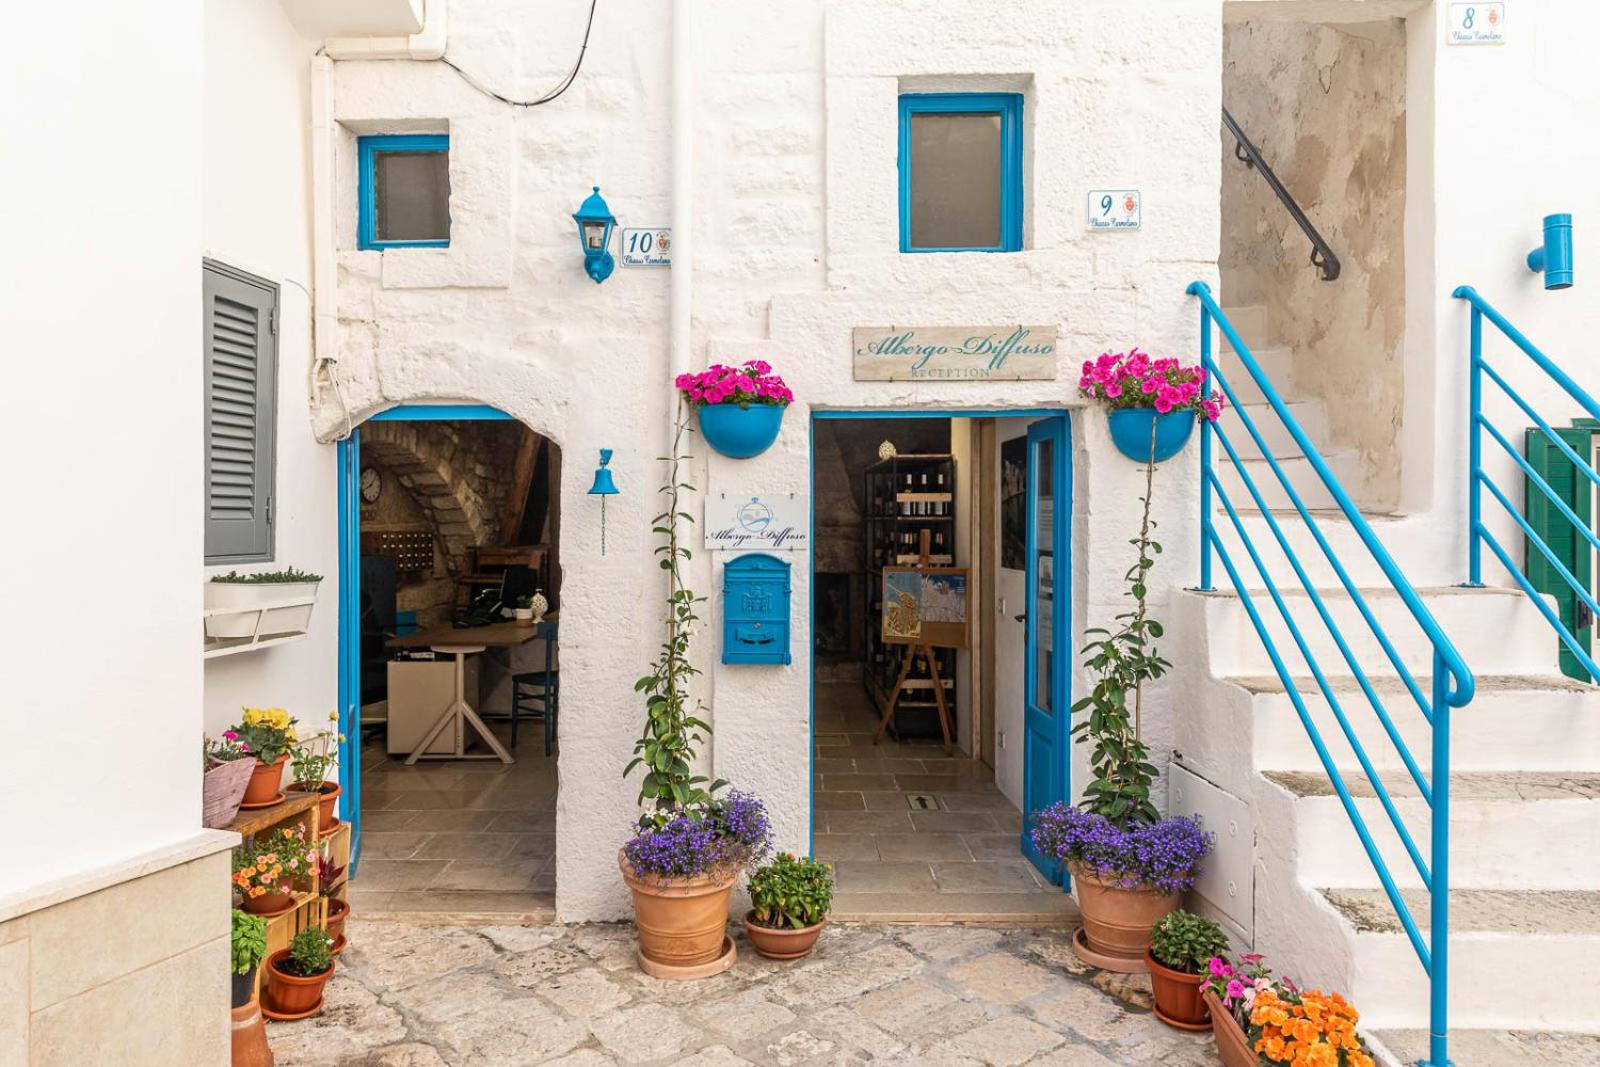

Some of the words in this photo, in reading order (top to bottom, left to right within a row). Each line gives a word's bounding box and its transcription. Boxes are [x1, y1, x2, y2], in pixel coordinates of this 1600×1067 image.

[1463, 7, 1475, 29] 8
[1101, 194, 1112, 217] 9
[630, 232, 653, 253] 10
[857, 331, 948, 369] Albergo
[952, 329, 1056, 369] Diffuso
[911, 366, 990, 378] RECEPTION
[705, 528, 752, 547] Albergo
[757, 527, 806, 547] Diffuso
